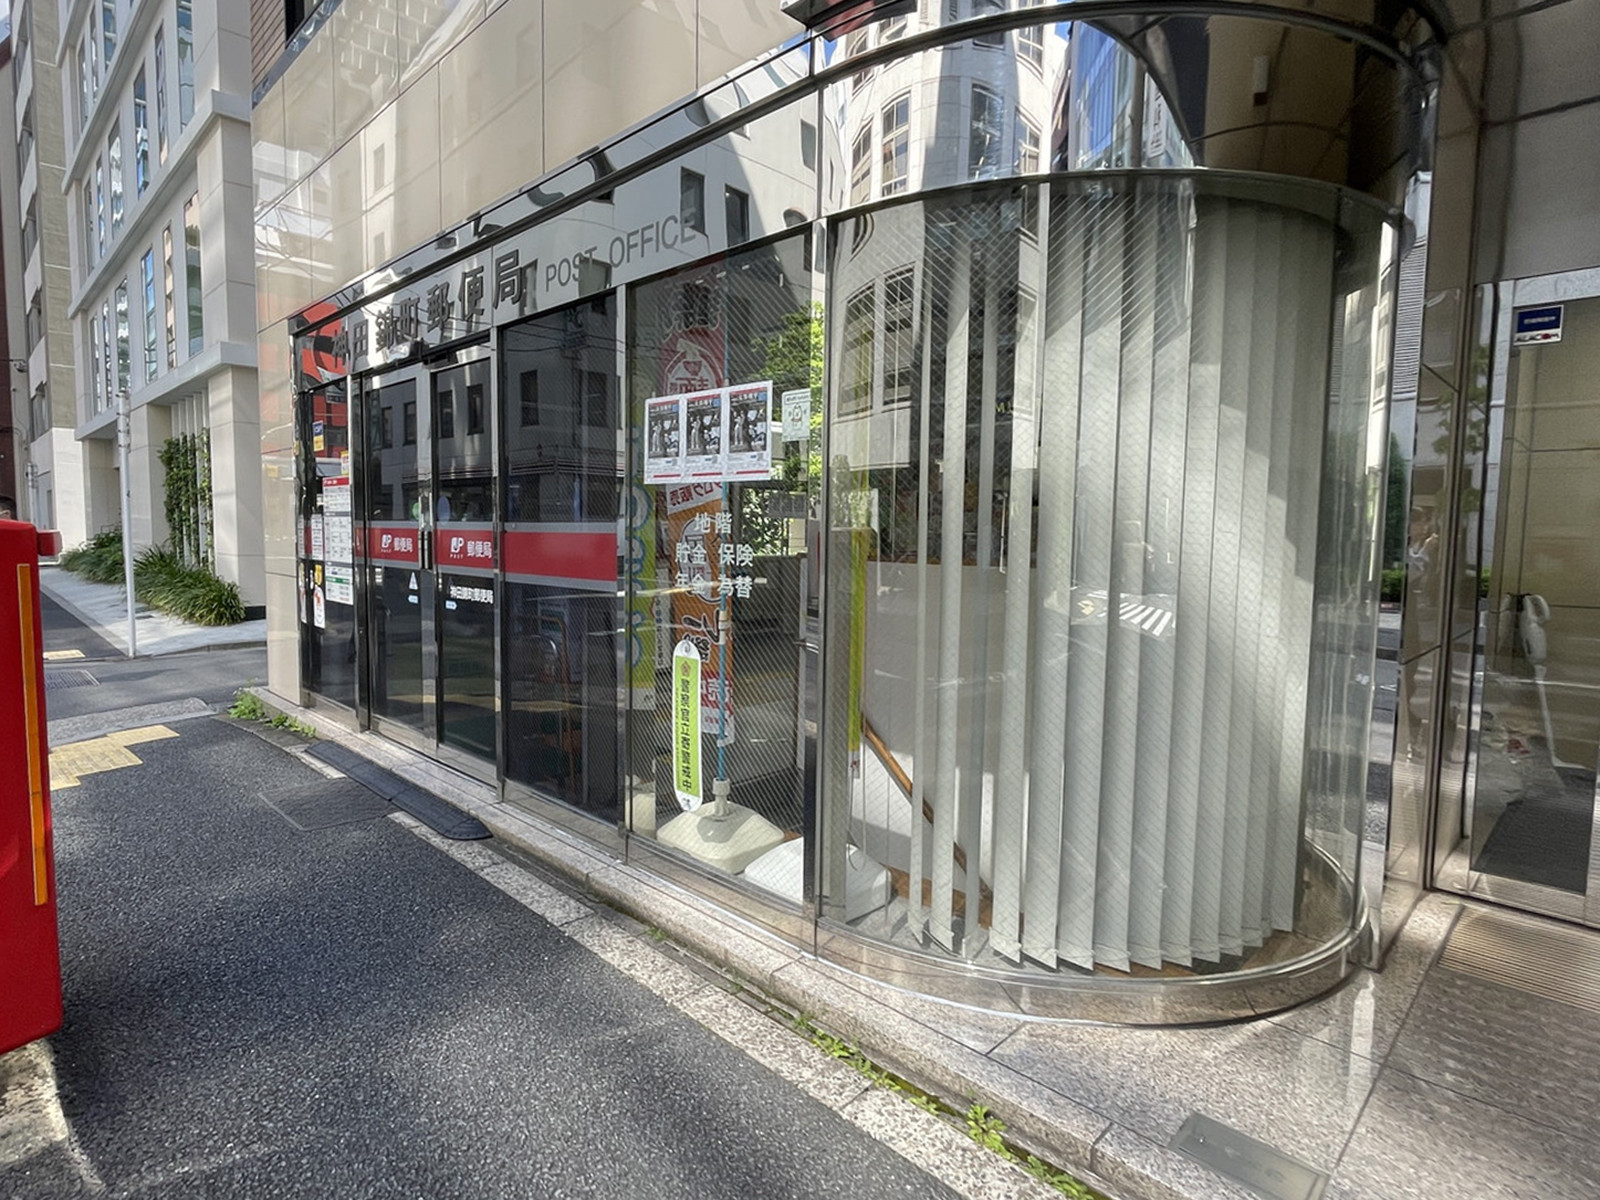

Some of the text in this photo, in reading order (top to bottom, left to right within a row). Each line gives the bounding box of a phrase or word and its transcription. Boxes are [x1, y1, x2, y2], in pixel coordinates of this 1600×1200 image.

[545, 207, 697, 292] POST OFFICE
[331, 249, 522, 369] 神田錦町郵便局
[394, 537, 413, 553] 郵便局
[466, 540, 493, 559] 郵便局
[675, 542, 754, 567] 貯金 保険
[675, 571, 753, 598] 年金 為替
